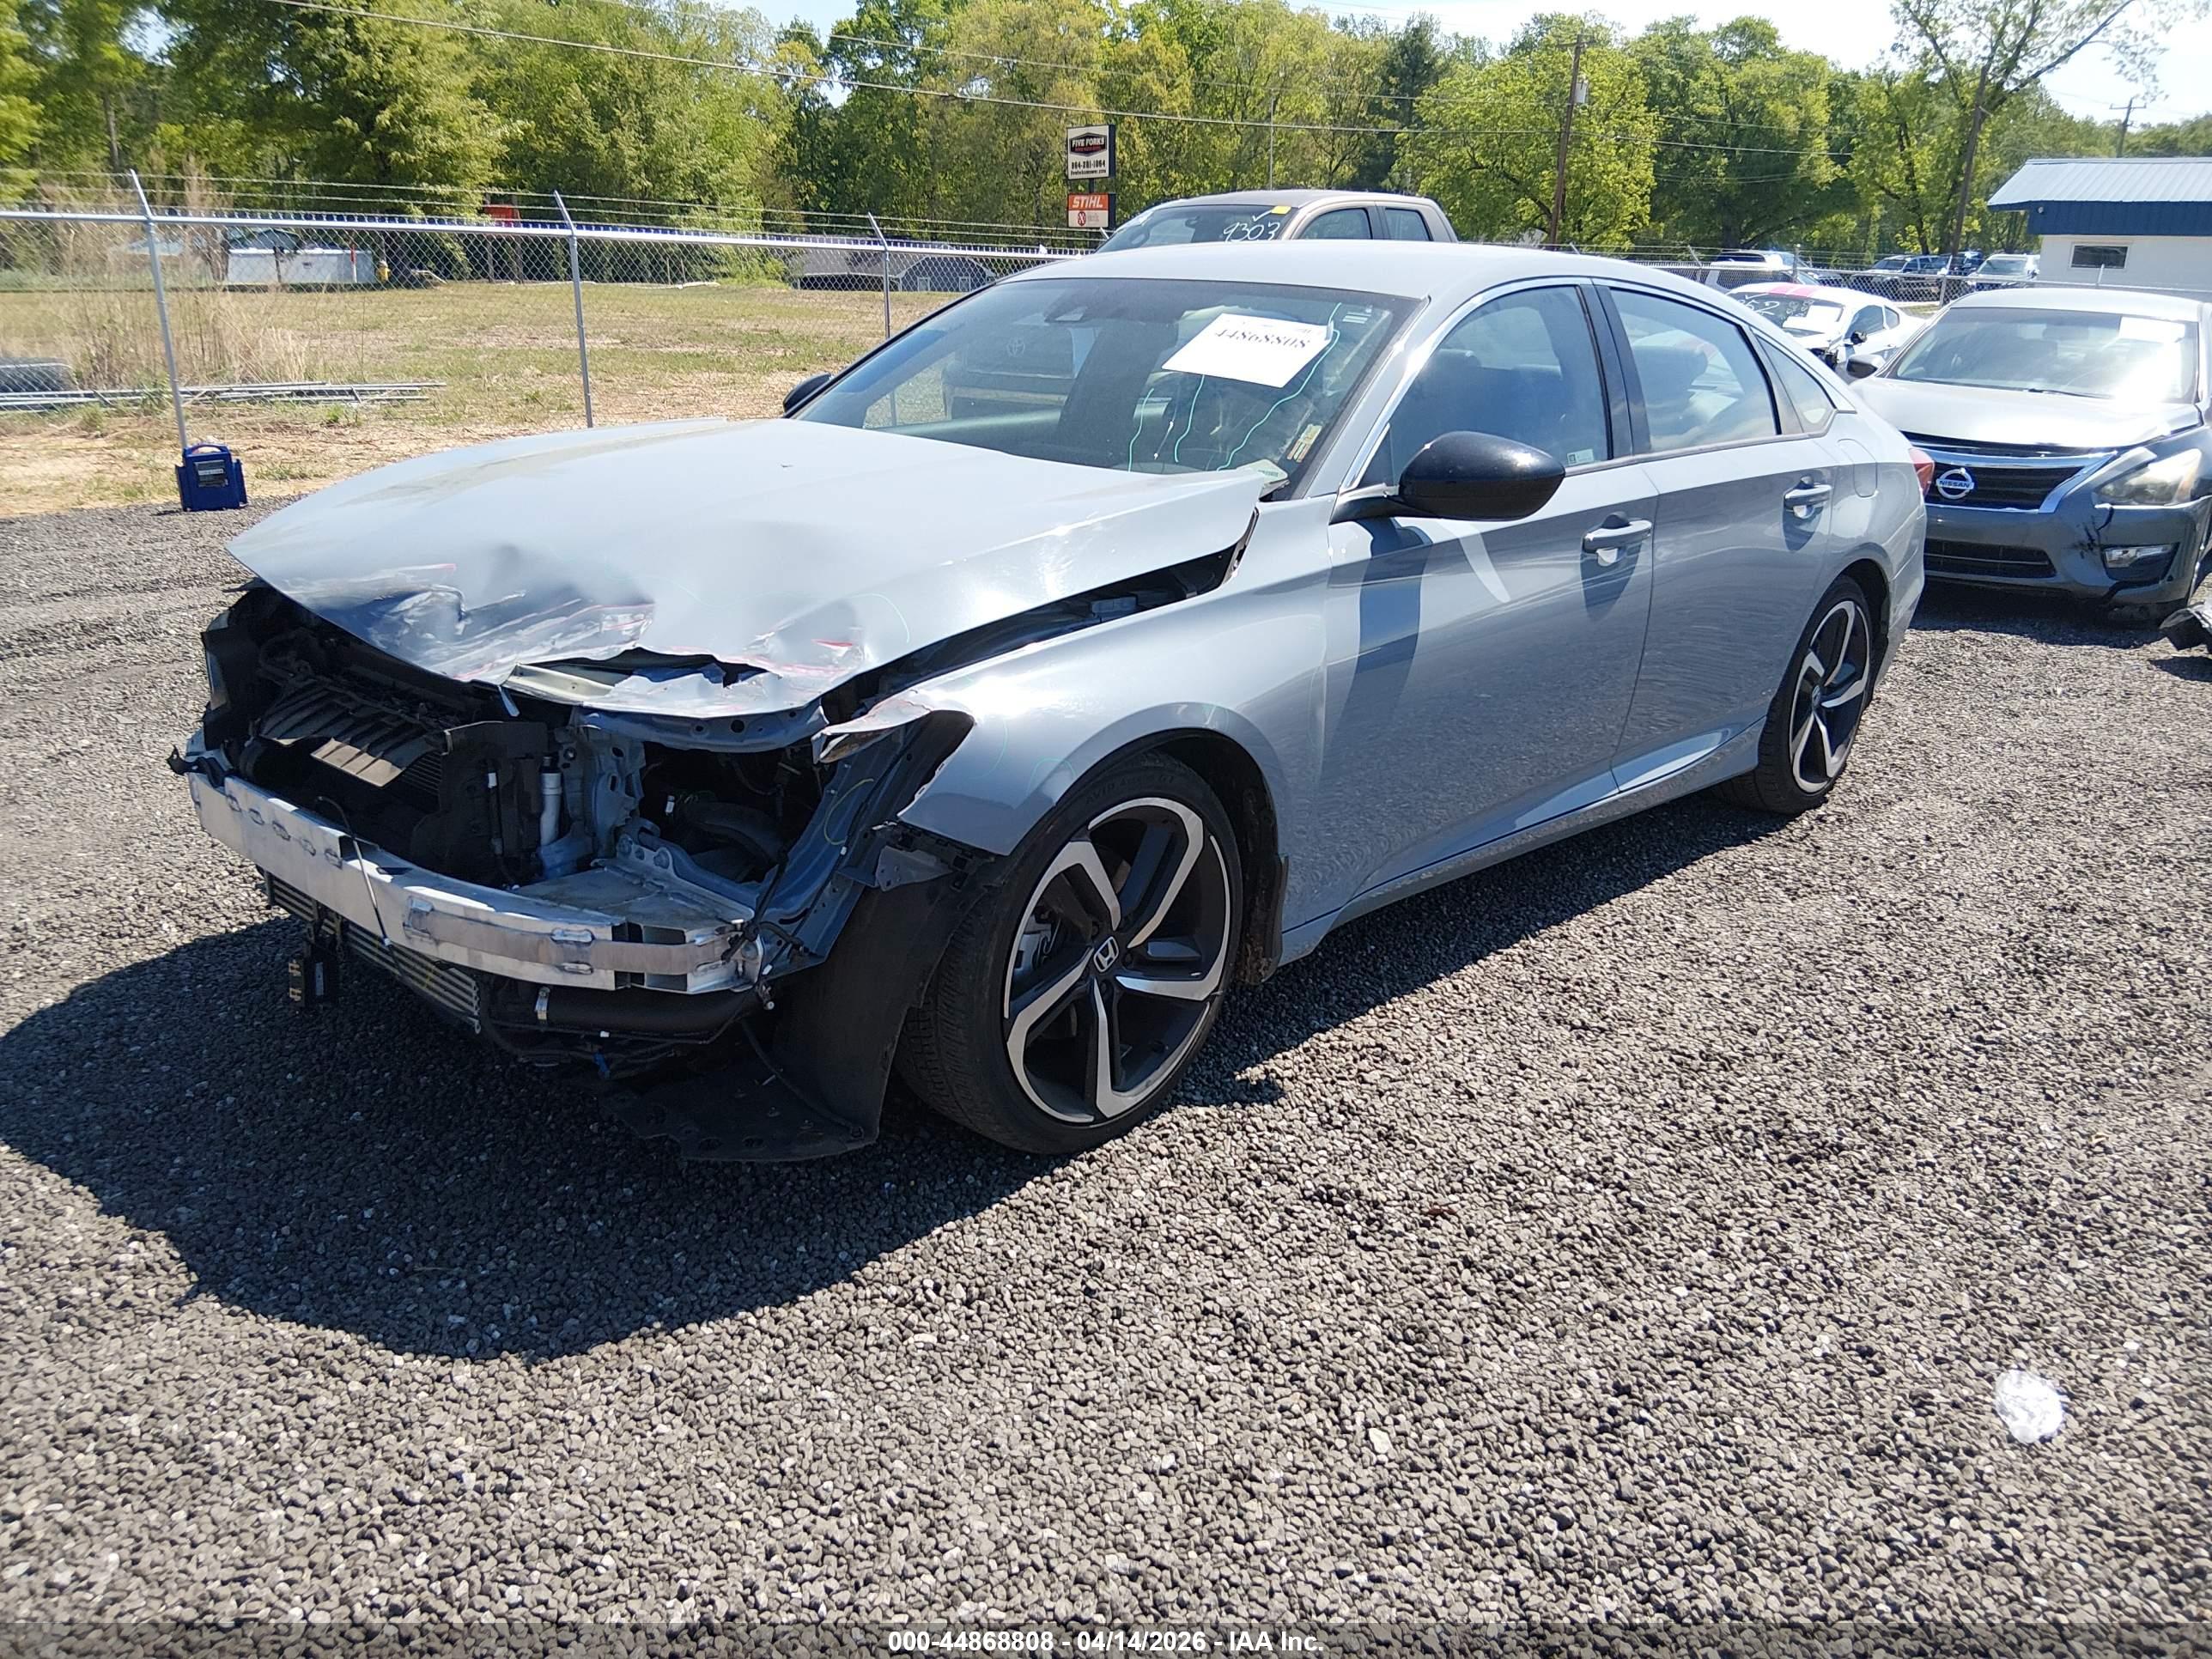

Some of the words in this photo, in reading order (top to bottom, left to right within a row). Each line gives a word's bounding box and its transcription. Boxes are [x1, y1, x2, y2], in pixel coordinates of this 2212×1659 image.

[1072, 138, 1085, 147] FIVE
[1085, 137, 1104, 146] FORKS
[1072, 195, 1103, 209] STIHL
